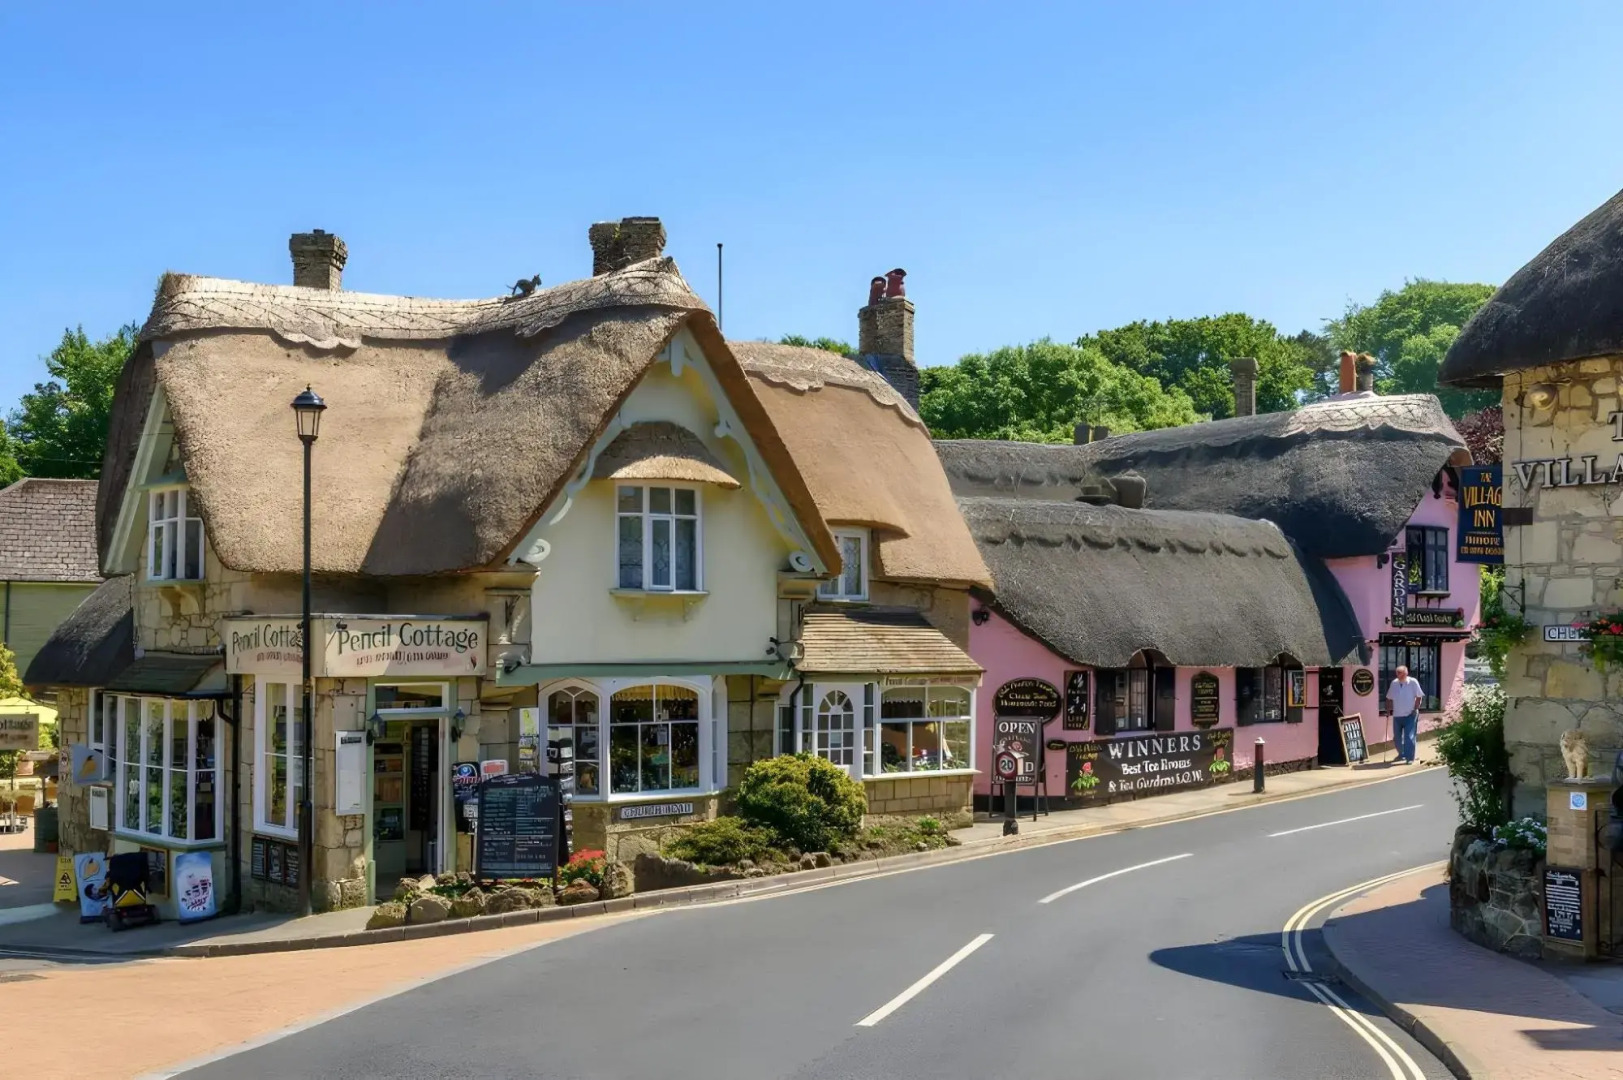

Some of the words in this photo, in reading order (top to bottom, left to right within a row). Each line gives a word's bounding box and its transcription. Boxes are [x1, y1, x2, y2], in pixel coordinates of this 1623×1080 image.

[1473, 509, 1496, 528] INN
[1393, 560, 1406, 616] GARDEN
[338, 623, 392, 655] Pencil
[399, 622, 479, 653] Cottage
[998, 721, 1036, 734] OPEN
[1107, 734, 1201, 760] WINNERS
[1000, 759, 1014, 772] 20
[1121, 763, 1142, 775] Best
[1107, 780, 1117, 793] &
